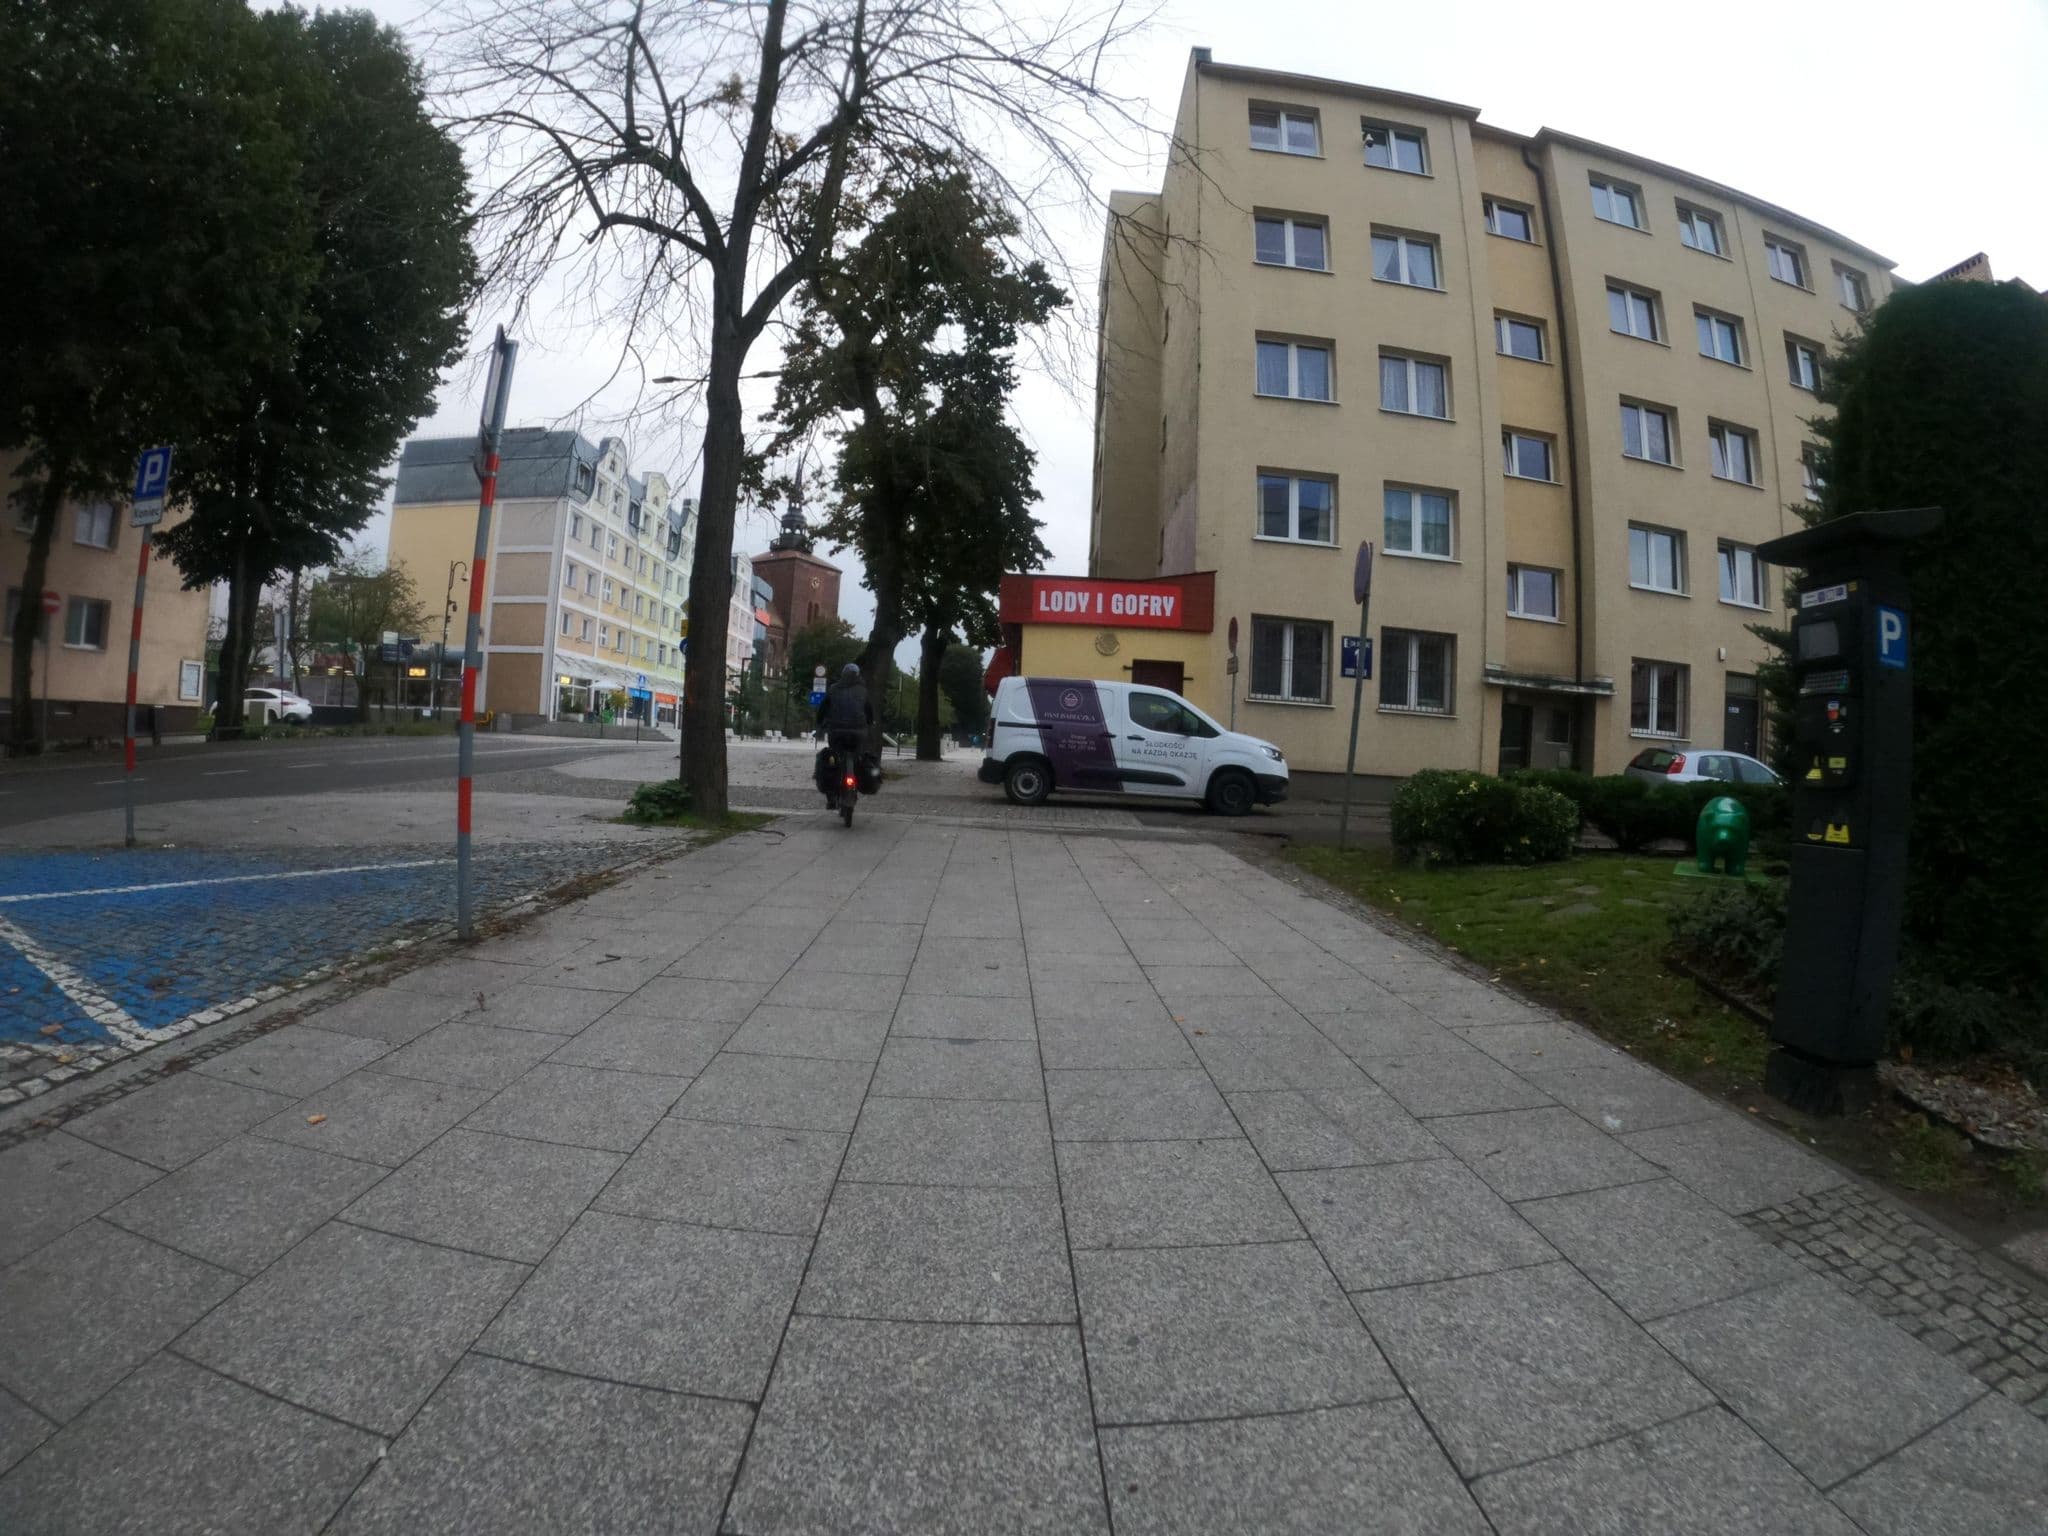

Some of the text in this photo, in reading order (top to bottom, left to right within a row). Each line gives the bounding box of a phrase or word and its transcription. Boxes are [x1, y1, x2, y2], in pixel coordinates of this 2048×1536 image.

[142, 453, 164, 494] P
[1040, 590, 1174, 617] LODY I GOFRY
[1881, 609, 1902, 655] P
